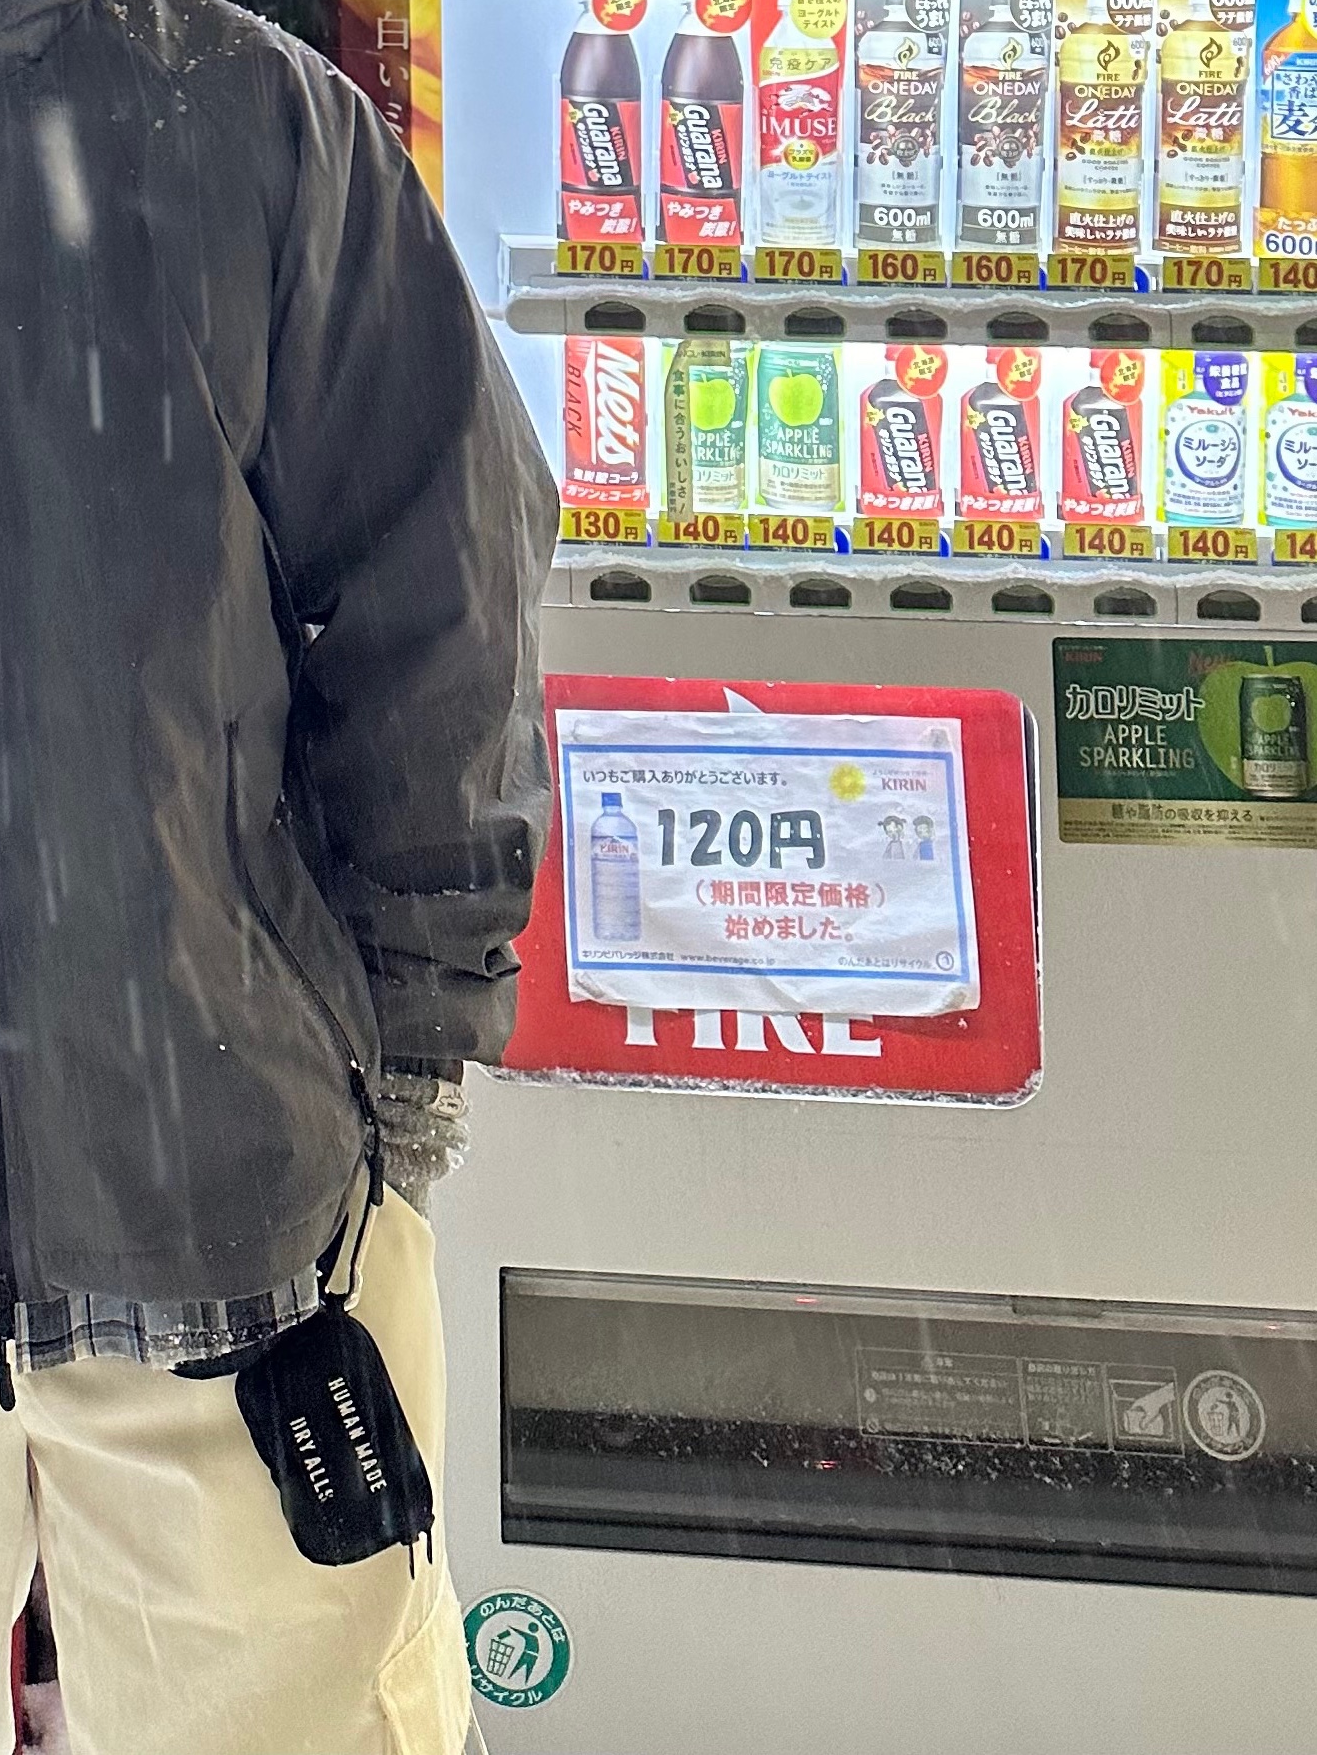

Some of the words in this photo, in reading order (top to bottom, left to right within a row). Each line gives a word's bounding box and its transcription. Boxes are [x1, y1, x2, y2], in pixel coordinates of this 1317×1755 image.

[797, 8, 841, 19] ヨーグルト
[802, 19, 836, 30] テイスト
[768, 56, 833, 71] 免疫ケア
[893, 70, 920, 81] FIRE
[998, 70, 1024, 81] FIRE
[1095, 71, 1121, 83] FIRE
[1198, 69, 1223, 80] FIRE
[867, 81, 938, 96] ONEDAY
[972, 81, 1042, 96] ONEDAY
[1073, 84, 1137, 99] ONEDAY
[1176, 82, 1239, 96] ONEDAY
[864, 95, 937, 124] Black
[967, 95, 1040, 126] Black
[582, 102, 623, 187] Guarana
[610, 126, 627, 162] KIRIN
[683, 104, 724, 190] Guarana
[711, 128, 729, 166] KIRIN
[567, 199, 624, 217] やみつき
[666, 201, 724, 220] やみつき
[873, 206, 931, 229] 600ml
[977, 208, 1034, 229] 600ml
[1068, 212, 1135, 227] 直火仕上げの
[568, 244, 634, 273] 170円
[868, 252, 938, 283] 160円
[566, 363, 583, 438] BLACK
[595, 340, 641, 468] Mets
[1186, 404, 1235, 416] Yakult
[777, 428, 820, 445] APPLE
[1184, 435, 1237, 451] ミルージュ
[764, 440, 833, 459] SPARKLING
[1195, 454, 1229, 468] ソーダ
[771, 465, 826, 481] カロリミット
[570, 510, 639, 540] 130円
[1065, 683, 1207, 722] カロリミット
[1103, 724, 1168, 745] APPLE
[1079, 746, 1196, 769] SPARKLING
[582, 769, 789, 787] いつもご購入ありがとうございます。
[881, 777, 928, 792] KIRIN
[657, 808, 827, 871] 120円
[695, 878, 887, 909] (期間限定価格)
[725, 915, 855, 942] 始めました。
[327, 1376, 367, 1441] HUMAN
[354, 1442, 388, 1494] MADE
[303, 1456, 334, 1504] ALLS
[479, 1596, 566, 1644] のんだあとは
[470, 1664, 543, 1706] リサイクル
